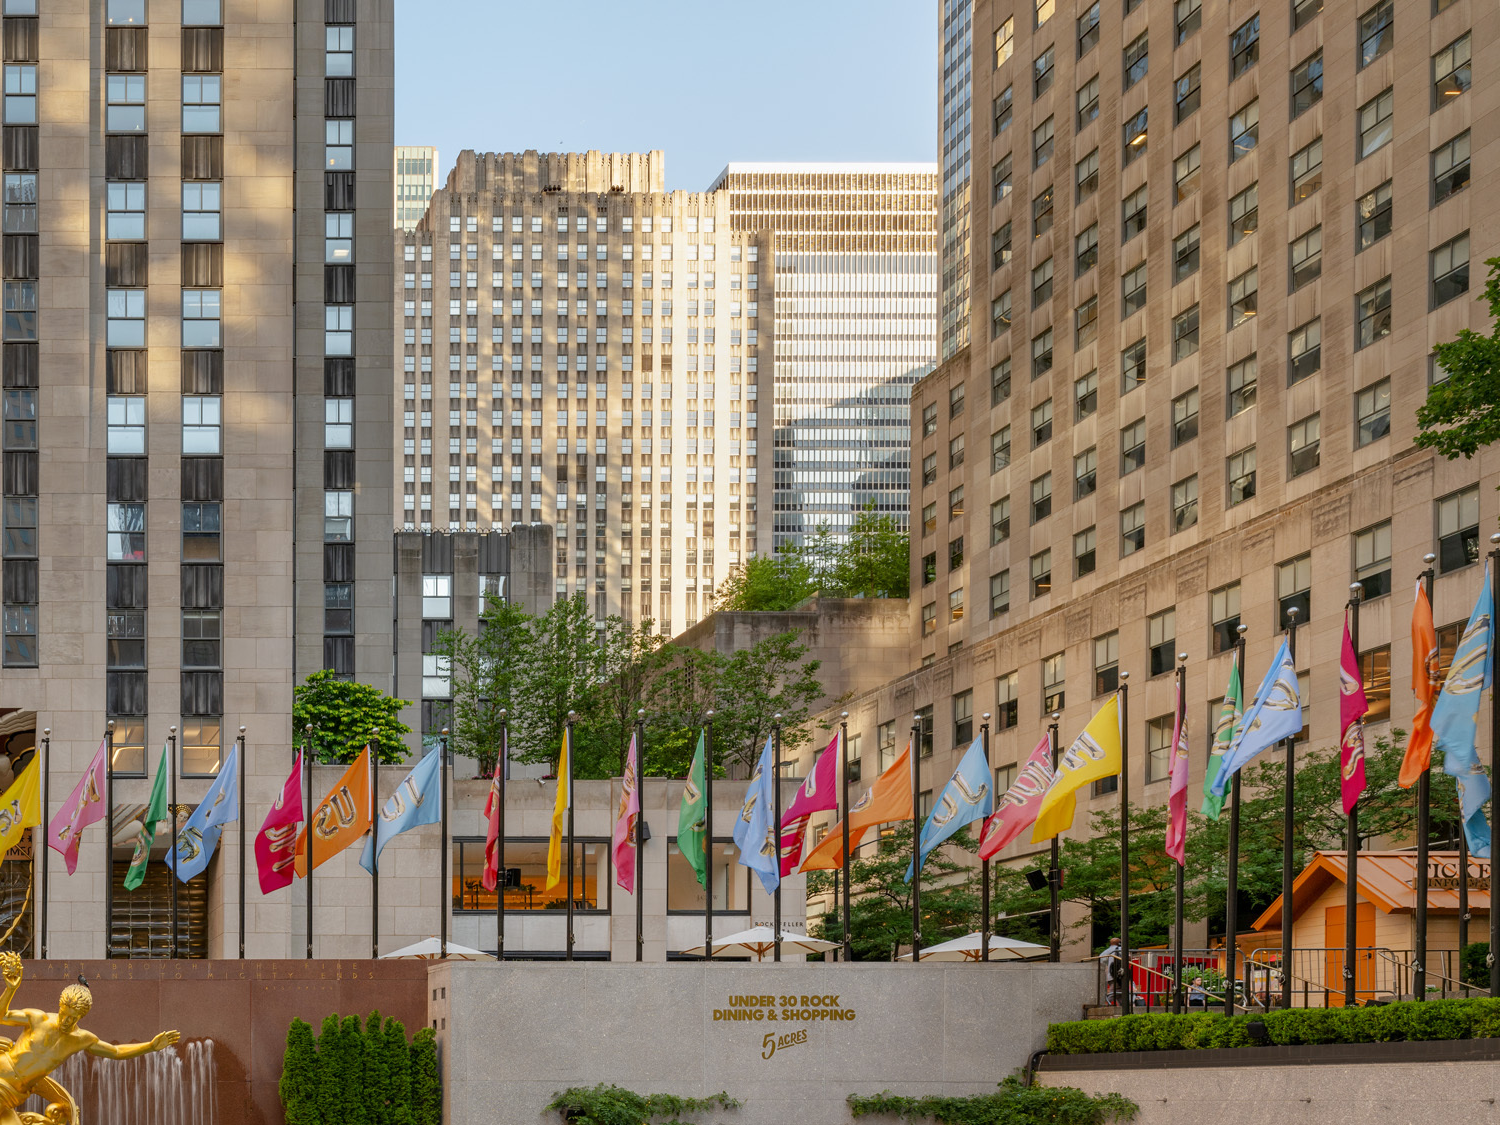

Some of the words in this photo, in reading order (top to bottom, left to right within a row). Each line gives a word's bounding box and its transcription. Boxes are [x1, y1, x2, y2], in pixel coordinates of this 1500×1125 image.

[48, 962, 84, 970] ART
[304, 962, 358, 970] FIRE
[729, 995, 776, 1007] UNDER
[780, 995, 798, 1007] 30
[801, 995, 840, 1007] ROCK
[713, 1009, 764, 1020] DINING
[767, 1009, 778, 1020] &
[781, 1009, 856, 1020] SHOPPING
[761, 1032, 776, 1059] 5
[777, 1029, 808, 1048] ACRES
